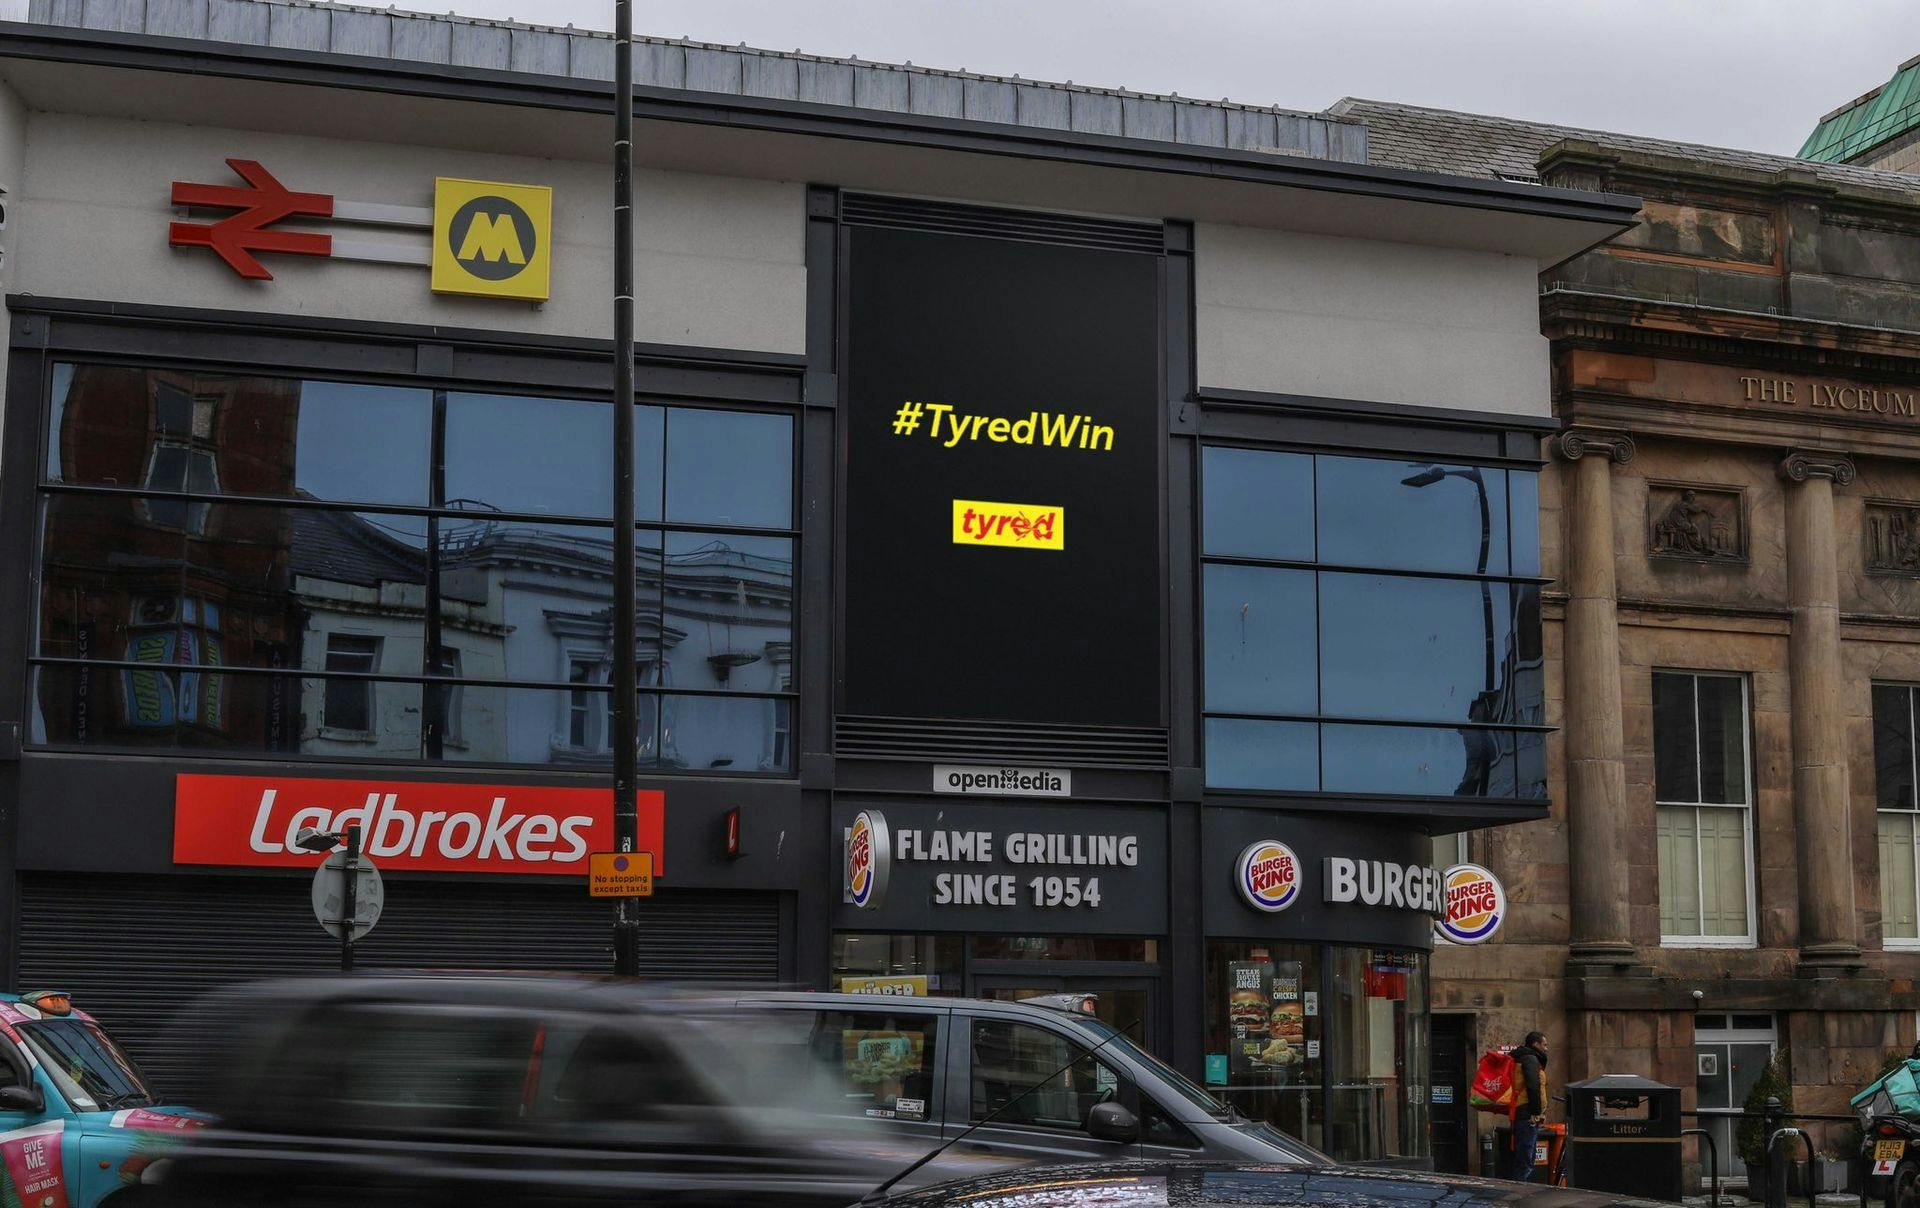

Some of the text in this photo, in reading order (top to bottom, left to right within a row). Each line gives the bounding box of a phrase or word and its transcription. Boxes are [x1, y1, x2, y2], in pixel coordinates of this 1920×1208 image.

[1739, 376, 1917, 417] THE LYCEUM
[891, 400, 1115, 451] #TyredWin
[962, 507, 1056, 542] tyred
[249, 788, 594, 863] Ladbrokes
[897, 829, 1138, 867] FLAME GRILLING
[594, 875, 648, 884] No stopping
[1251, 856, 1292, 878] BURGER
[1253, 866, 1294, 893] KING
[594, 884, 648, 894] except taxis
[934, 873, 1101, 908] SINCE 1954
[1331, 856, 1442, 914] BURGER
[1446, 881, 1495, 904] BURGER
[1444, 893, 1496, 924] KING
[1236, 980, 1261, 989] ANGUS
[1273, 992, 1298, 1000] CHICKEN
[23, 1138, 43, 1154] GIVE
[25, 1150, 46, 1170] ME
[24, 1176, 60, 1194] HAIR MASK
